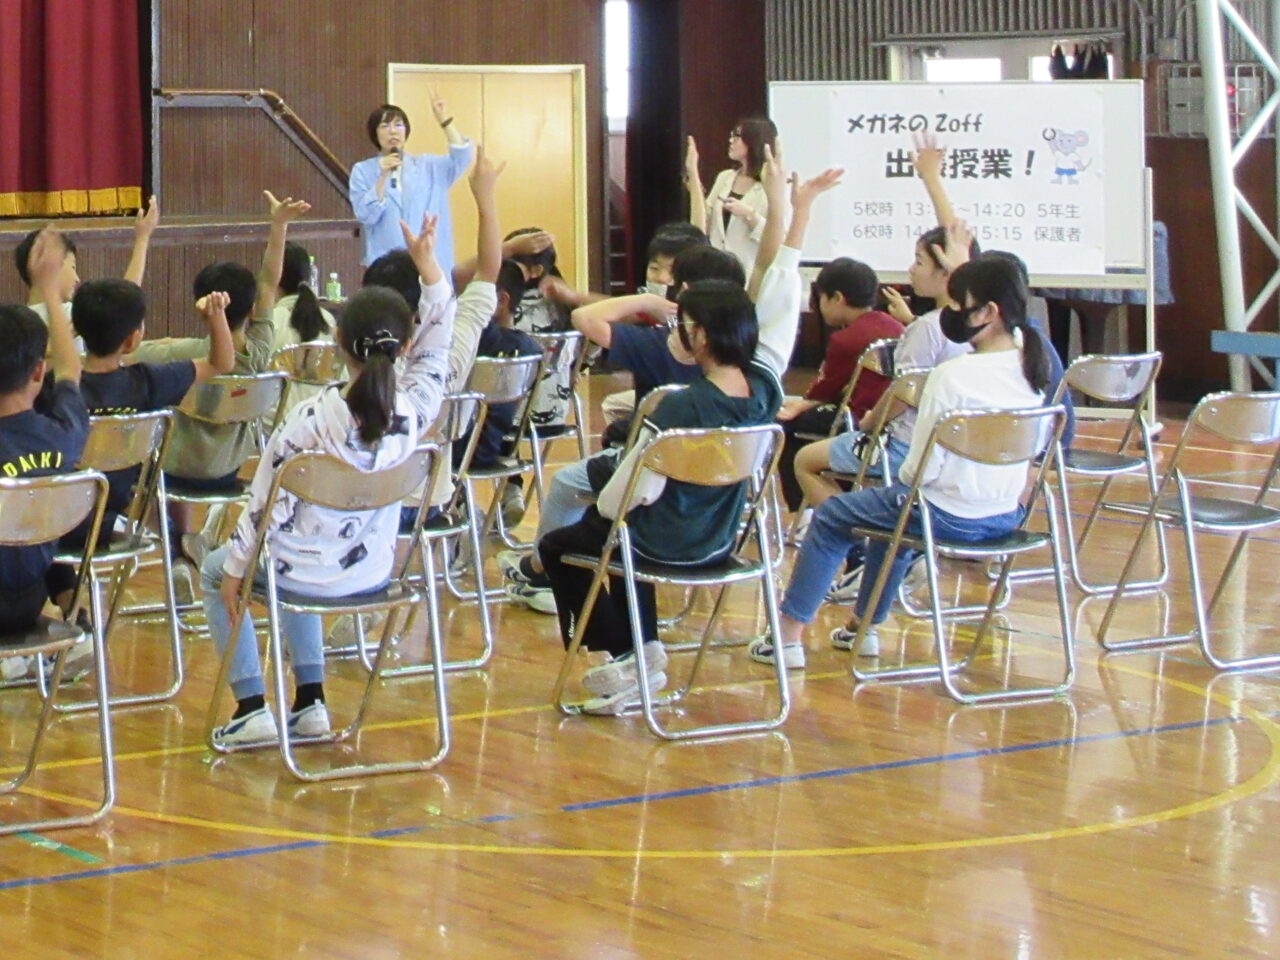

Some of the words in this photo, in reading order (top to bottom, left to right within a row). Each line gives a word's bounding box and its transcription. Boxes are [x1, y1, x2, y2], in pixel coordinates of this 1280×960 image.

[847, 113, 928, 134] メガネの
[935, 112, 983, 133] Zoff
[885, 148, 1036, 178] 出授業！
[853, 201, 895, 218] 5校時
[1037, 203, 1081, 220] 5年生
[852, 224, 894, 241] 6校時
[1034, 226, 1081, 242] 保護者
